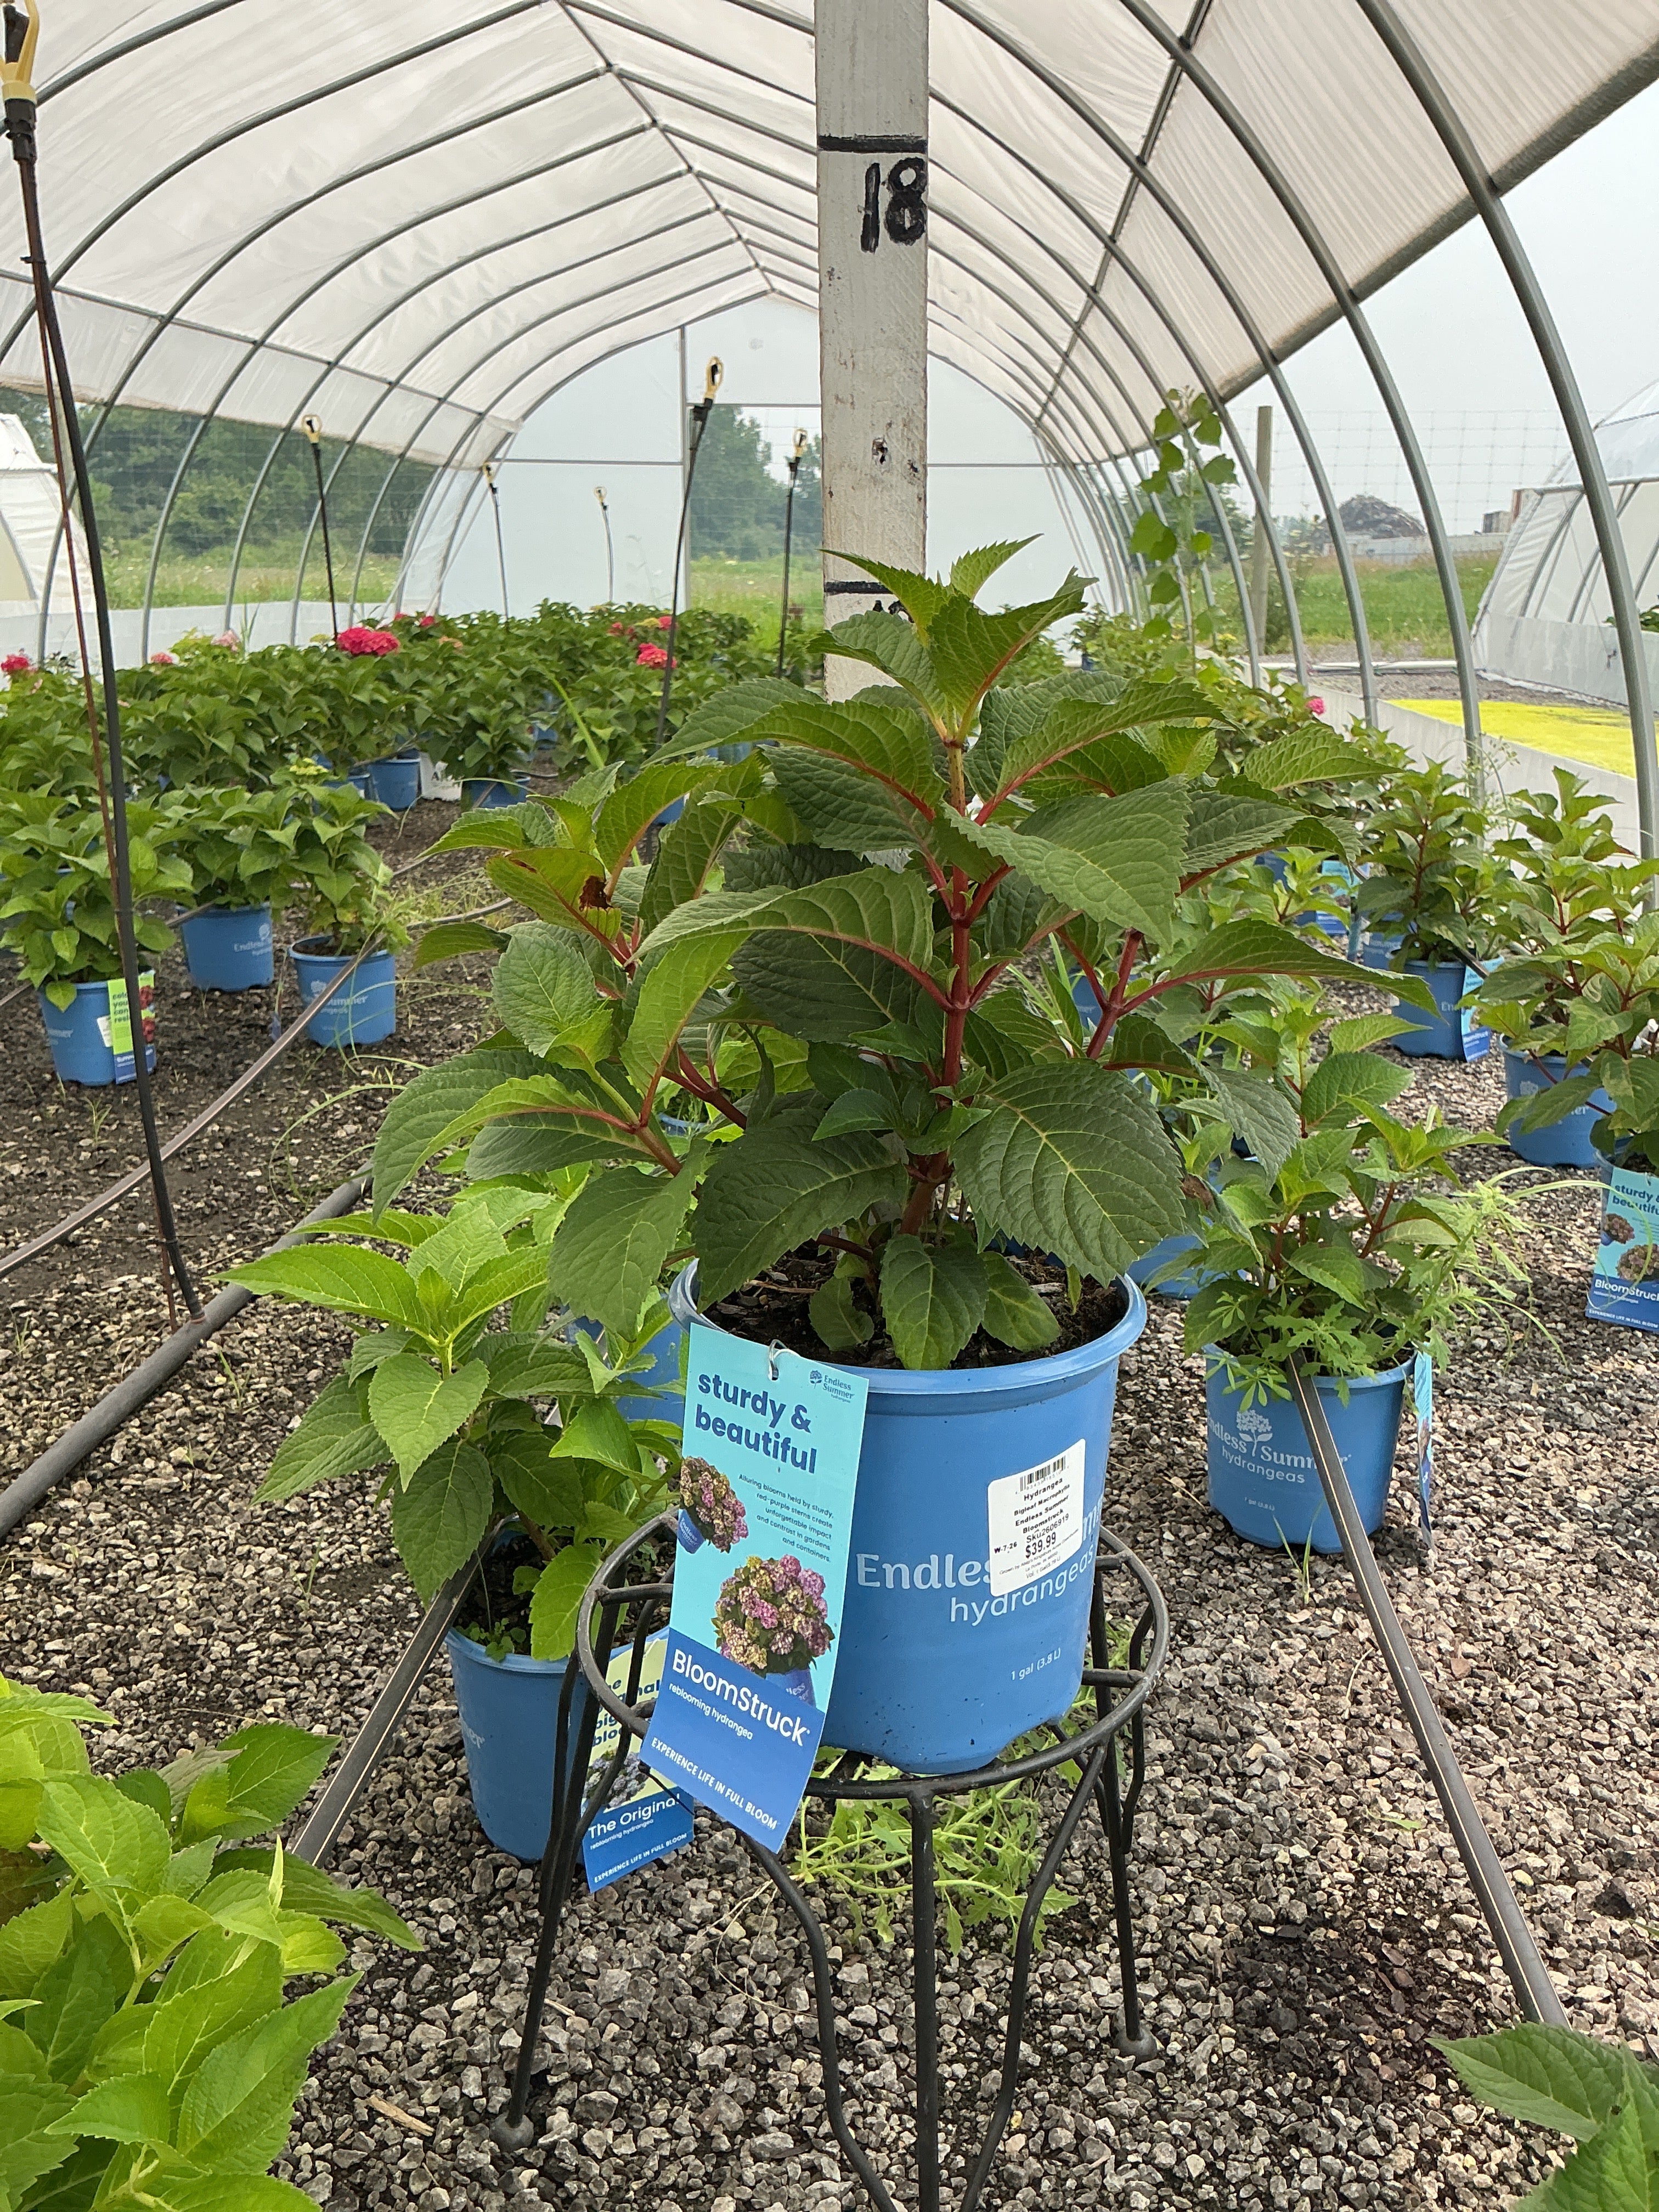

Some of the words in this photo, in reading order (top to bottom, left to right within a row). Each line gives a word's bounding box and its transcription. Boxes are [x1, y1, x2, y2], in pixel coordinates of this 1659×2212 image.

[861, 157, 928, 253] 18
[1613, 1195, 1659, 1215] beautifu
[1615, 1185, 1653, 1203] sturdy
[823, 1383, 853, 1399] Summer
[824, 1375, 851, 1390] Endless
[697, 1373, 786, 1429] sturdy
[791, 1404, 811, 1434] &
[695, 1404, 817, 1474] beautiful
[1222, 1446, 1305, 1484] hydrangeas
[739, 1474, 762, 1489] Alluring
[763, 1483, 786, 1498] blooms
[787, 1493, 802, 1505] held
[803, 1499, 810, 1509] by
[812, 1504, 834, 1519] sturdy,
[1024, 1477, 1063, 1502] Hydrangea
[757, 1493, 790, 1511] red-purple
[791, 1507, 810, 1520] stems
[812, 1516, 833, 1529] create
[765, 1507, 807, 1530] unforgettable
[809, 1525, 832, 1540] impact
[1014, 1502, 1036, 1516] Bigleaf
[1015, 1512, 1042, 1526] Endless
[1045, 1494, 1069, 1513] Summer
[1023, 1508, 1064, 1534] Bloomstruck
[757, 1515, 769, 1524] and
[770, 1520, 795, 1536] contrast
[804, 1536, 830, 1551] gardens
[782, 1537, 794, 1547] and
[1025, 1532, 1056, 1559] $39.99
[856, 1553, 990, 1589] Endle
[950, 1544, 1094, 1626] hydrangeas
[1011, 1672, 1015, 1680] 1
[1019, 1663, 1034, 1680] gal
[1037, 1652, 1052, 1672] (3.8
[1053, 1647, 1061, 1662] L)
[669, 1683, 712, 1717] reblooming
[712, 1707, 753, 1741] hydrangea
[672, 1649, 804, 1747] BloomStruck
[651, 1737, 698, 1776] EXPERIENCE
[698, 1768, 715, 1788] LIFE
[715, 1780, 726, 1794] IN
[726, 1787, 745, 1809] FULL
[744, 1801, 778, 1830] BLOOM
[588, 1820, 616, 1839] The
[619, 1793, 680, 1825] Original
[590, 1831, 623, 1850] reblooming
[623, 1819, 654, 1836] hydrangea
[594, 1860, 630, 1883] EXPERIENCE
[630, 1853, 642, 1864] LIFE
[651, 1844, 665, 1854] FULL
[665, 1833, 687, 1847] BLOOM
